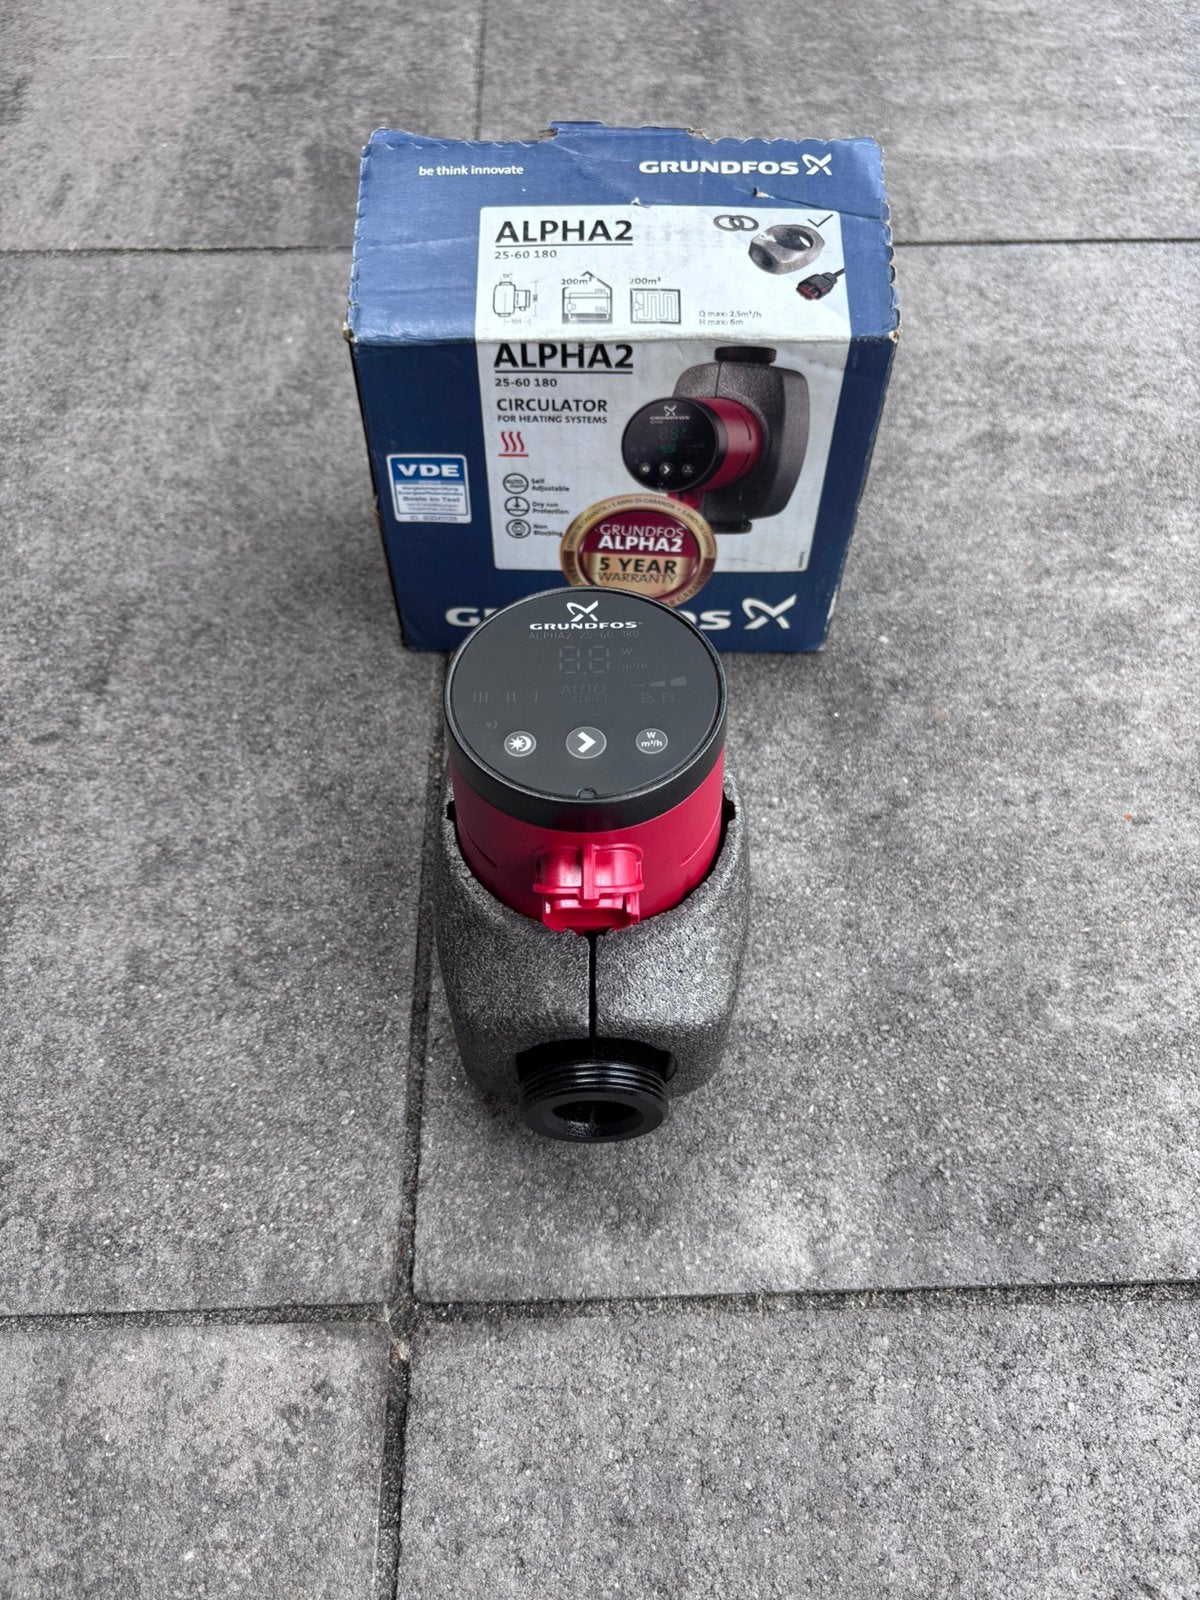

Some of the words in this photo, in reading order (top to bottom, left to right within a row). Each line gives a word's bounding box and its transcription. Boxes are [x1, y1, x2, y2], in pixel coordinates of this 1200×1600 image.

[419, 165, 434, 176] be
[436, 165, 468, 176] think
[471, 165, 524, 175] innovate
[639, 160, 799, 175] GRUNDFOS
[495, 219, 634, 243] ALPHA2
[494, 250, 530, 260] 25-60
[534, 249, 557, 259] 180
[493, 343, 634, 369] ALPHA2
[494, 378, 531, 388] 25-60
[534, 378, 558, 388] 180
[496, 398, 608, 413] CIRCULATOR
[497, 415, 517, 423] FOR
[519, 415, 562, 424] HEATING
[565, 416, 608, 424] SYSTEMS
[397, 464, 460, 477] VDE
[600, 524, 684, 538] GRUNDFOS
[598, 536, 683, 552] ALPHA2
[599, 558, 610, 571] 5
[618, 558, 677, 574] YEAR
[597, 572, 679, 584] WARRANTY
[529, 621, 638, 630] GRUNDFOS
[646, 731, 657, 739] W
[641, 739, 663, 747] m³/h
